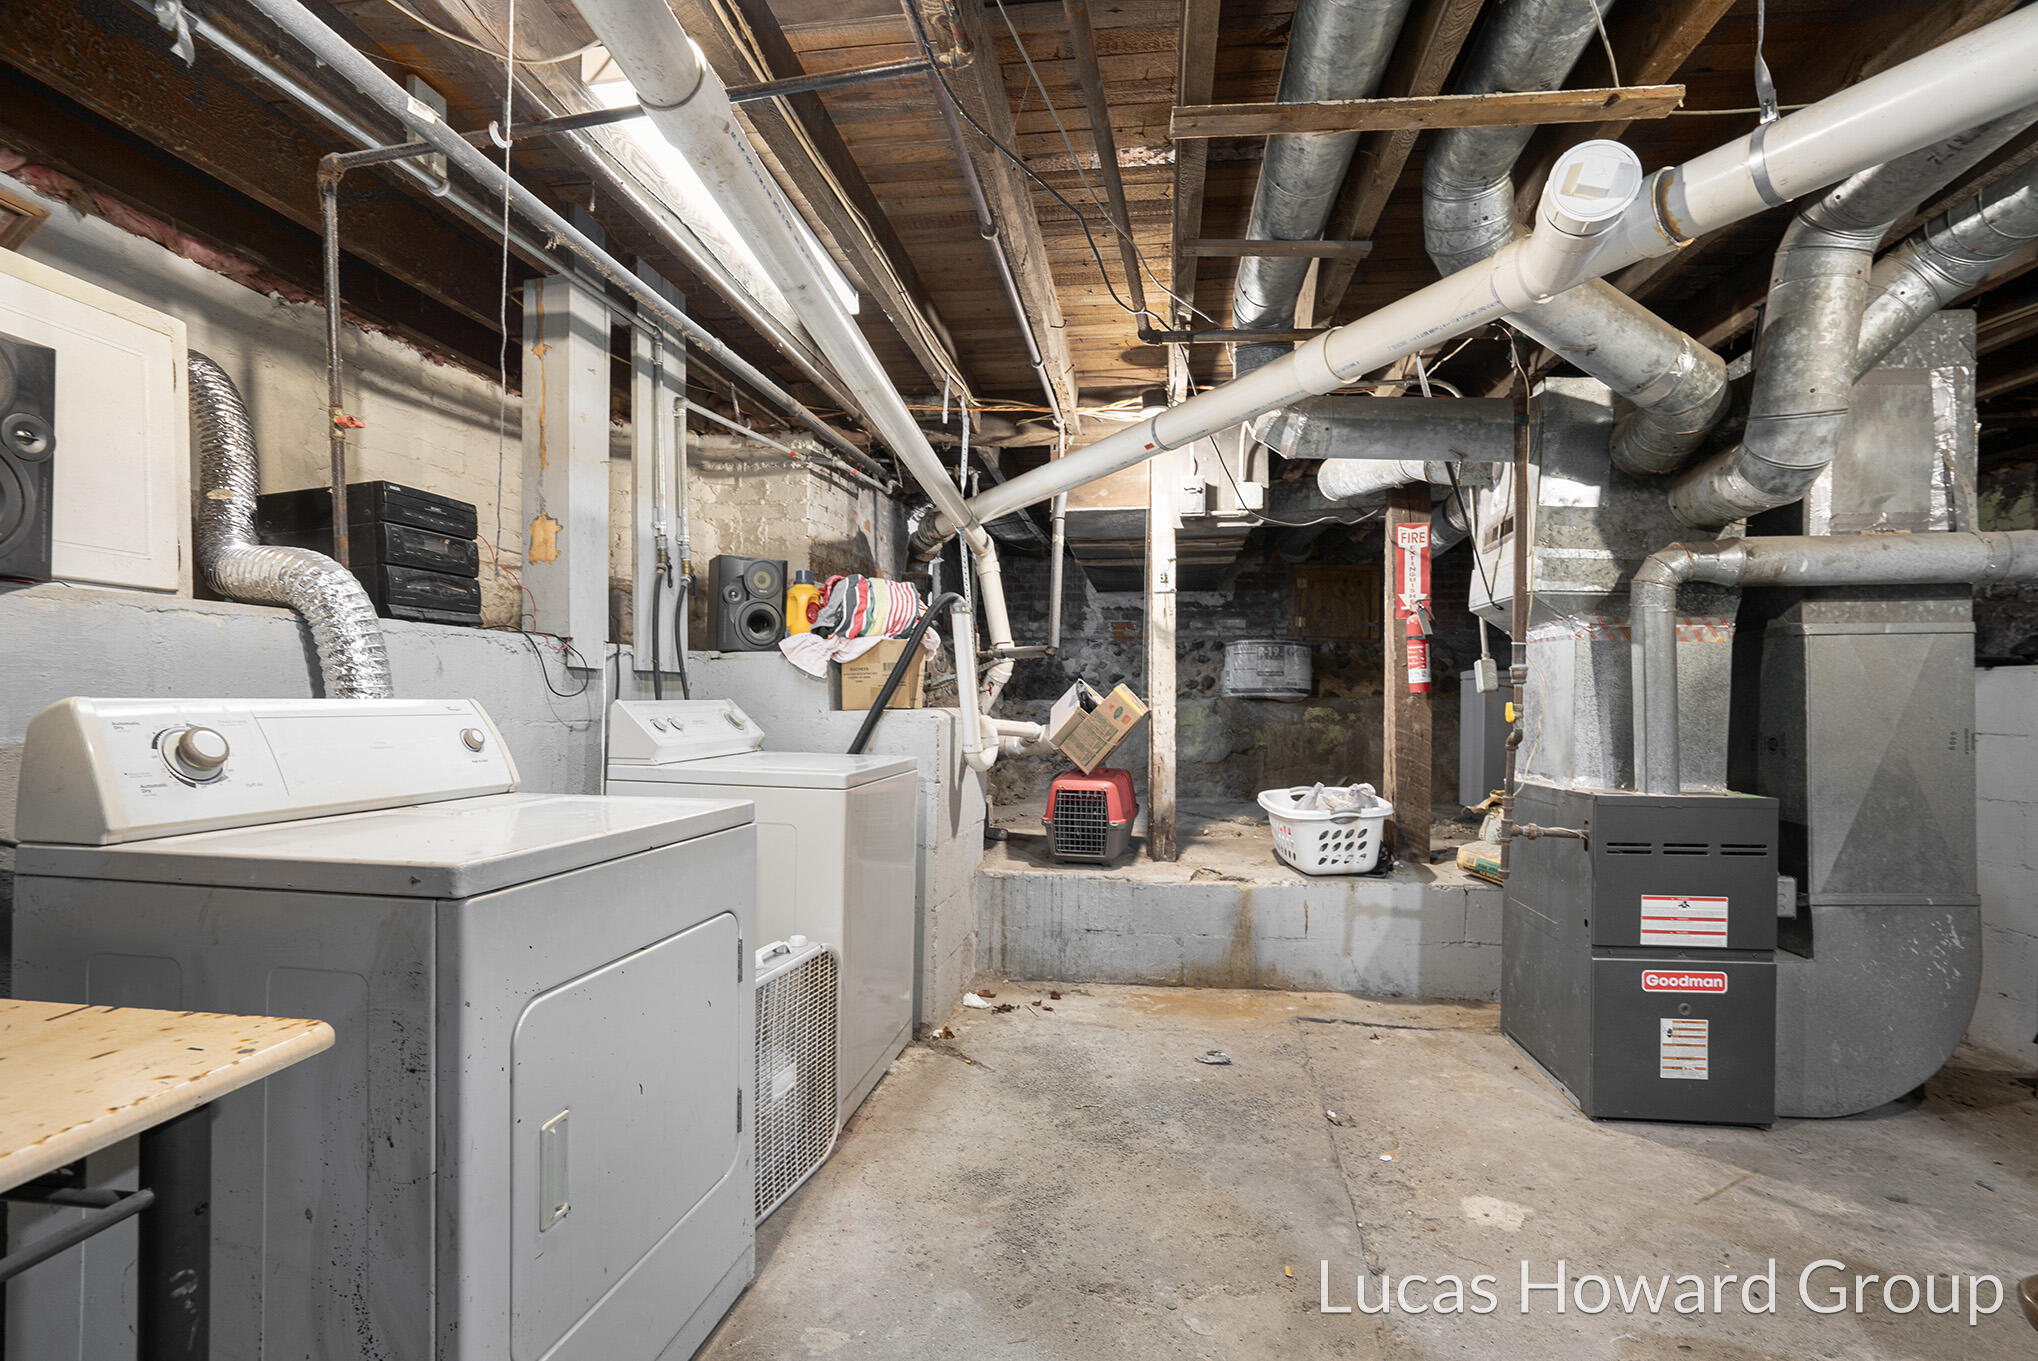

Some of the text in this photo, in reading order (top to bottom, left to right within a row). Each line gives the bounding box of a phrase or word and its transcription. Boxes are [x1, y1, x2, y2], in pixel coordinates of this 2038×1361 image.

[1401, 532, 1425, 544] FIRE
[1257, 646, 1280, 657] R-19
[1646, 974, 1723, 988] Goodman
